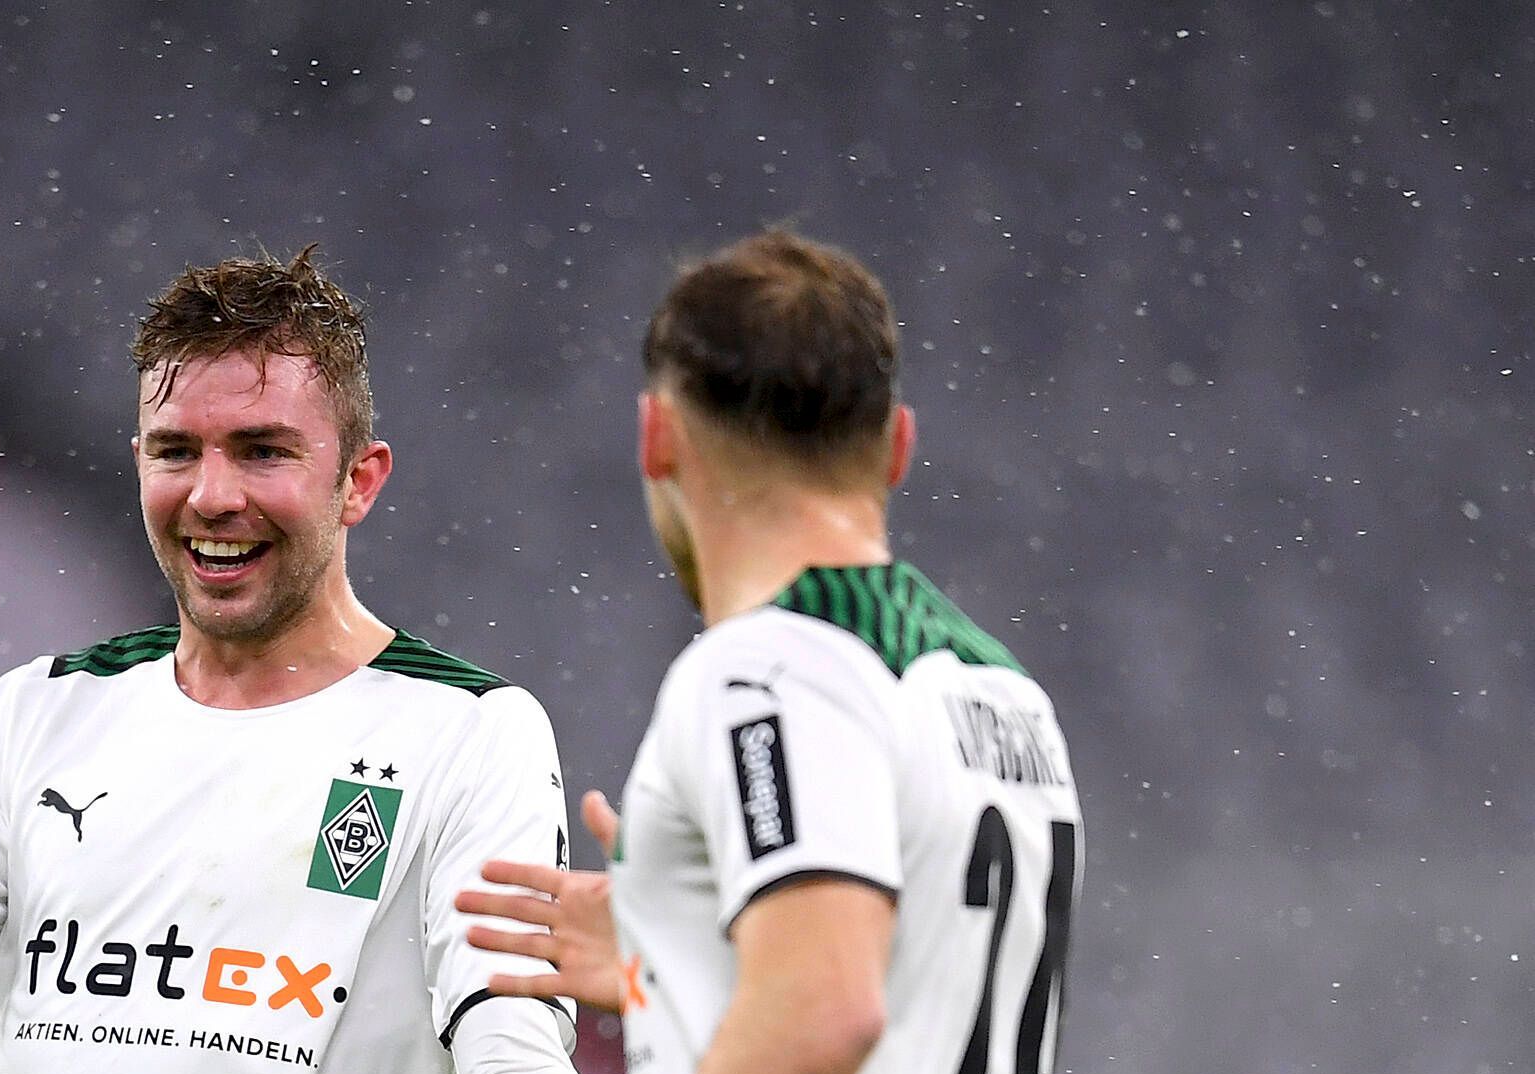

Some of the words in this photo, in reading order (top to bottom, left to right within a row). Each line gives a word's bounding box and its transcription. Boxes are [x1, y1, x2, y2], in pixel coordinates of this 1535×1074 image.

[14, 1023, 84, 1042] AKTIEN.
[91, 1025, 180, 1047] ONLINE.
[189, 1030, 319, 1069] HANDELN.
